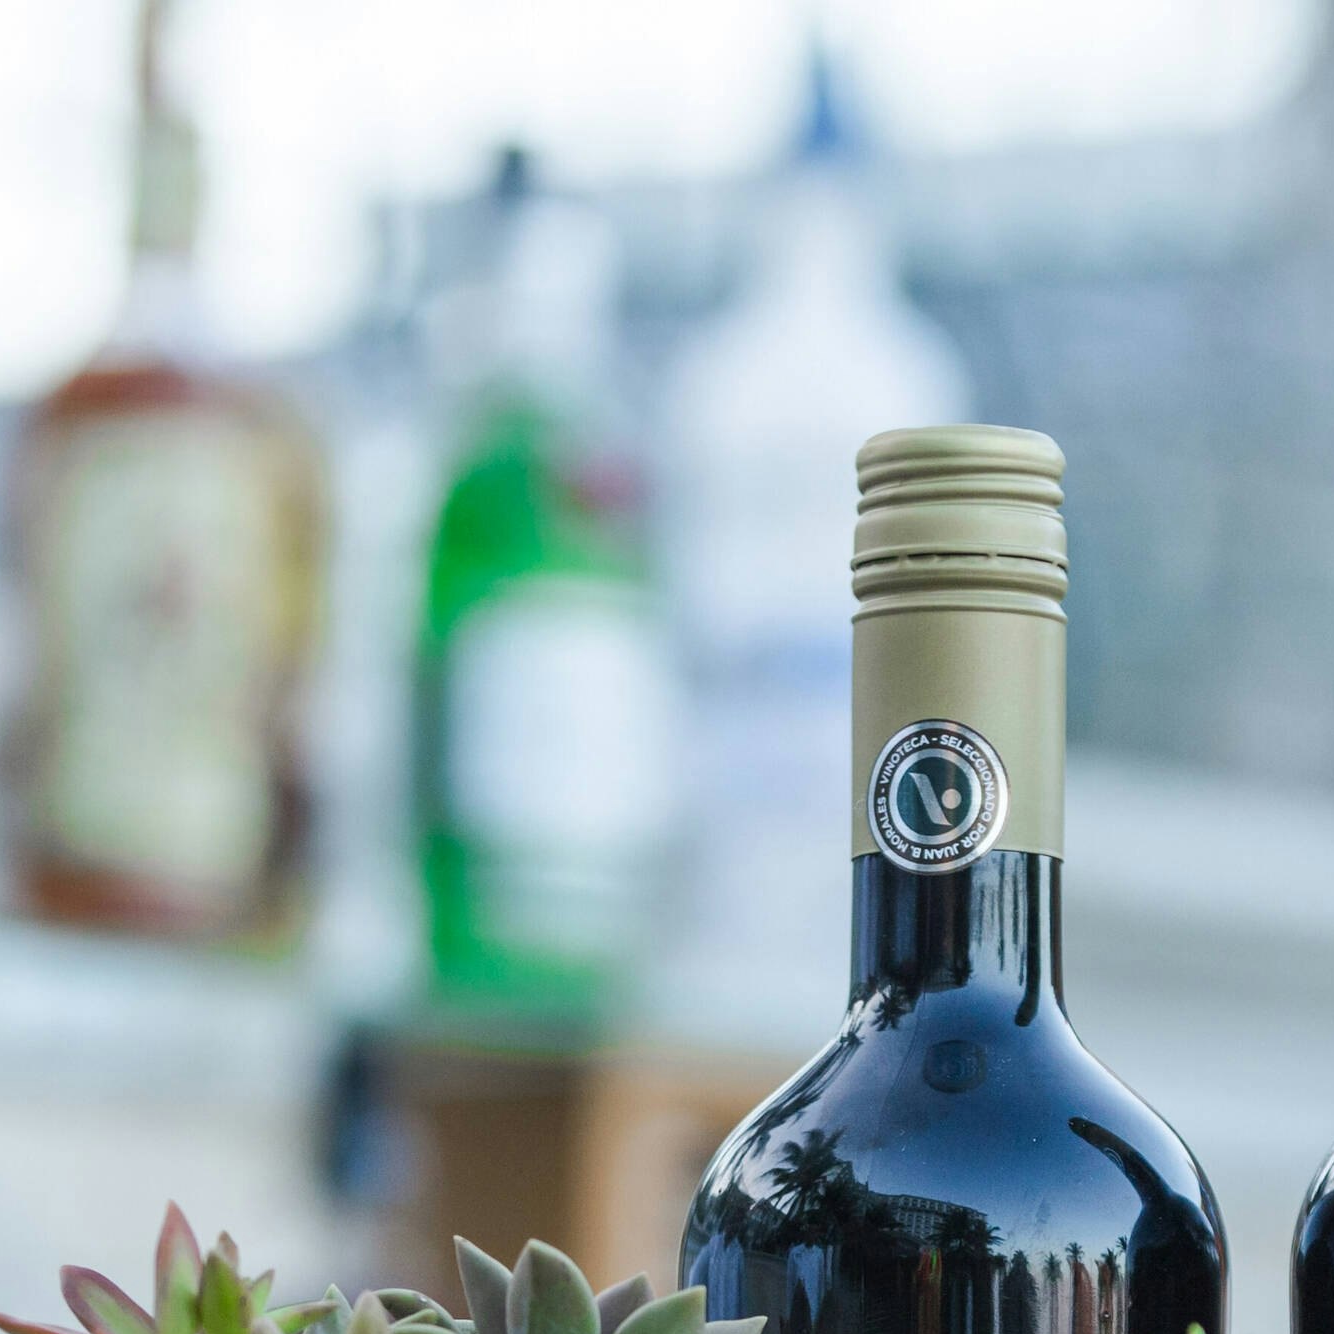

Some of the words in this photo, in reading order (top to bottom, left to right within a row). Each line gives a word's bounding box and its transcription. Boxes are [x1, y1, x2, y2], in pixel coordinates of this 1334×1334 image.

[879, 735, 929, 785] VINOTECA
[940, 734, 996, 822] SELECCIONADO
[877, 796, 910, 852] MORALES
[961, 822, 987, 849] POR
[910, 845, 922, 859] B.
[923, 842, 960, 860] JUAN
